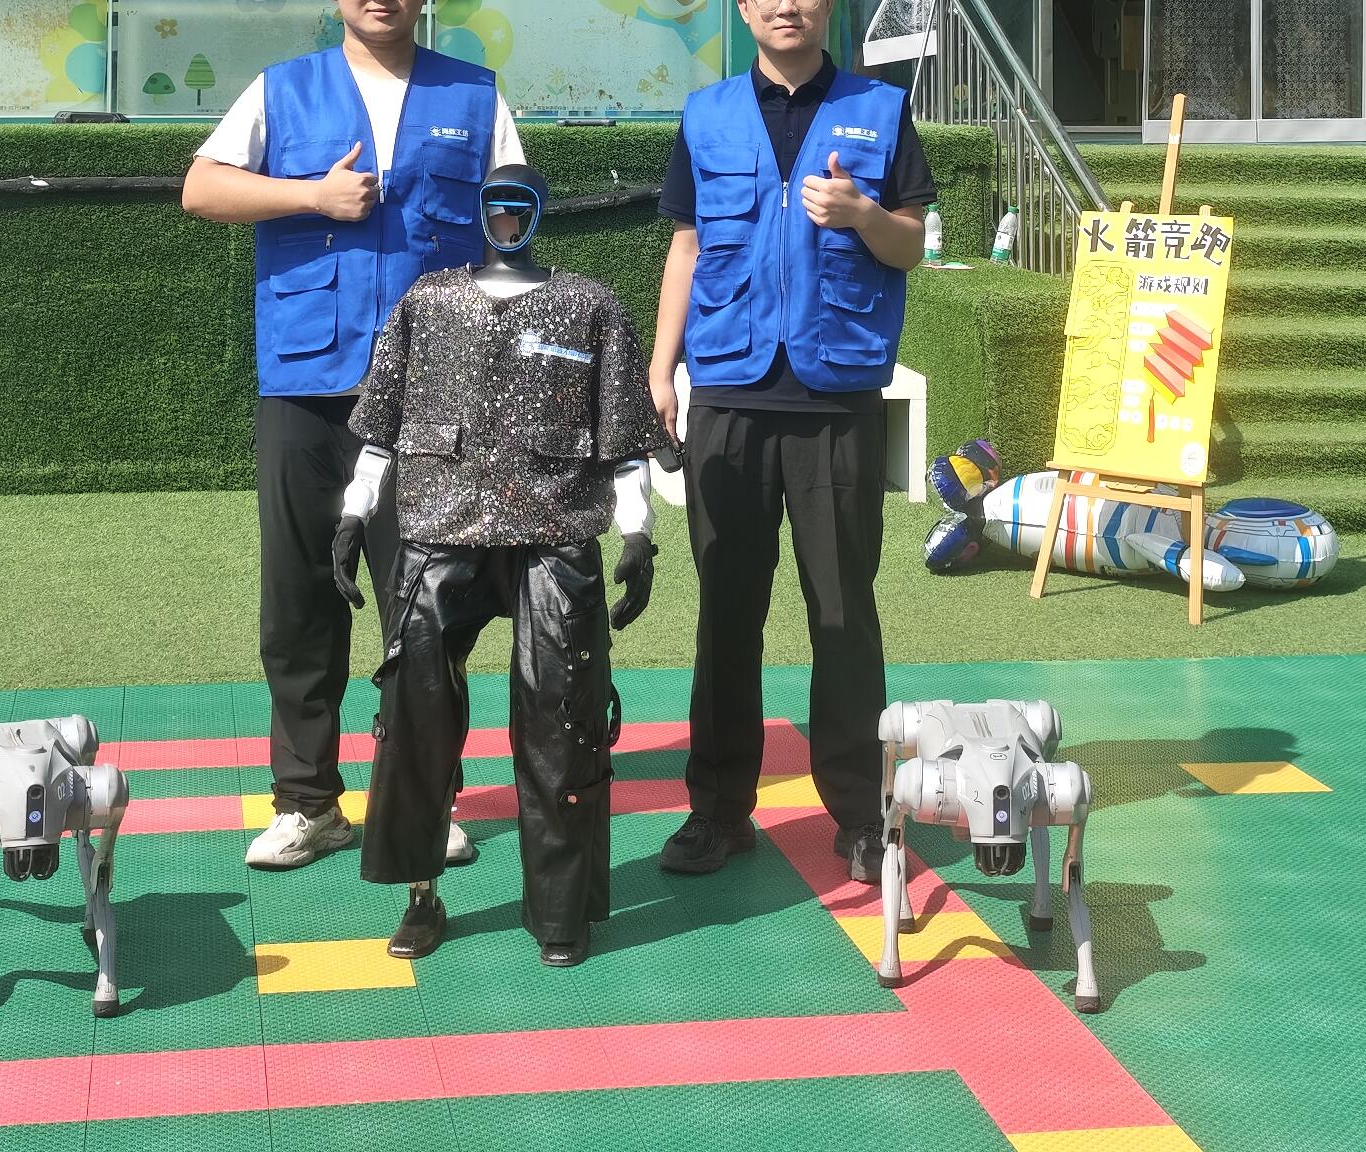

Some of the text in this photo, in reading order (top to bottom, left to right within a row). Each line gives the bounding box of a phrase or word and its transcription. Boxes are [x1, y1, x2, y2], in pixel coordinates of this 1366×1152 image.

[1083, 217, 1232, 267] 火箭竞跑
[1138, 274, 1210, 296] 游戏规则
